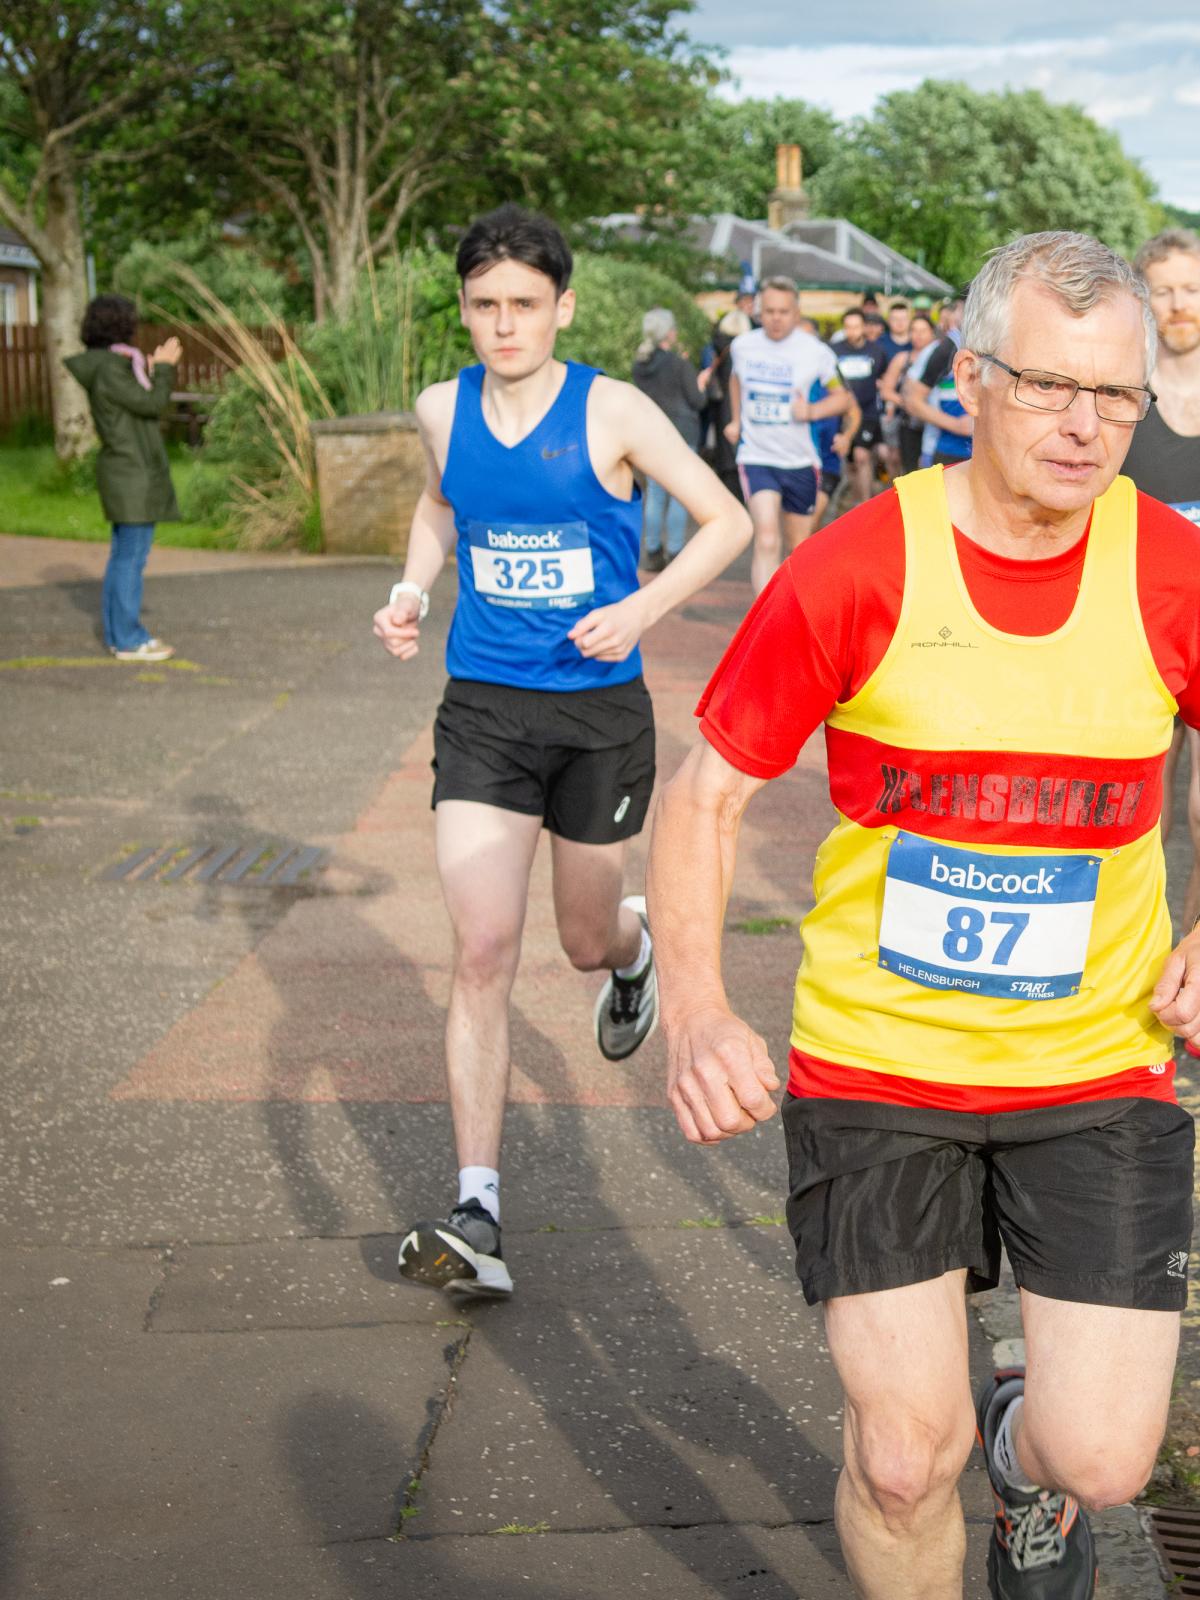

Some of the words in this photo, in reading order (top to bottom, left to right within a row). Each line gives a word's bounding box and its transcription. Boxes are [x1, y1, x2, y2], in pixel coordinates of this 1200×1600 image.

[487, 529, 560, 549] babcock
[494, 558, 565, 590] 325
[931, 855, 1056, 894] babcock
[942, 906, 1031, 966] 87
[898, 962, 981, 989] HELENSBURGH
[1010, 981, 1051, 993] START
[1027, 990, 1055, 998] FITNESS
